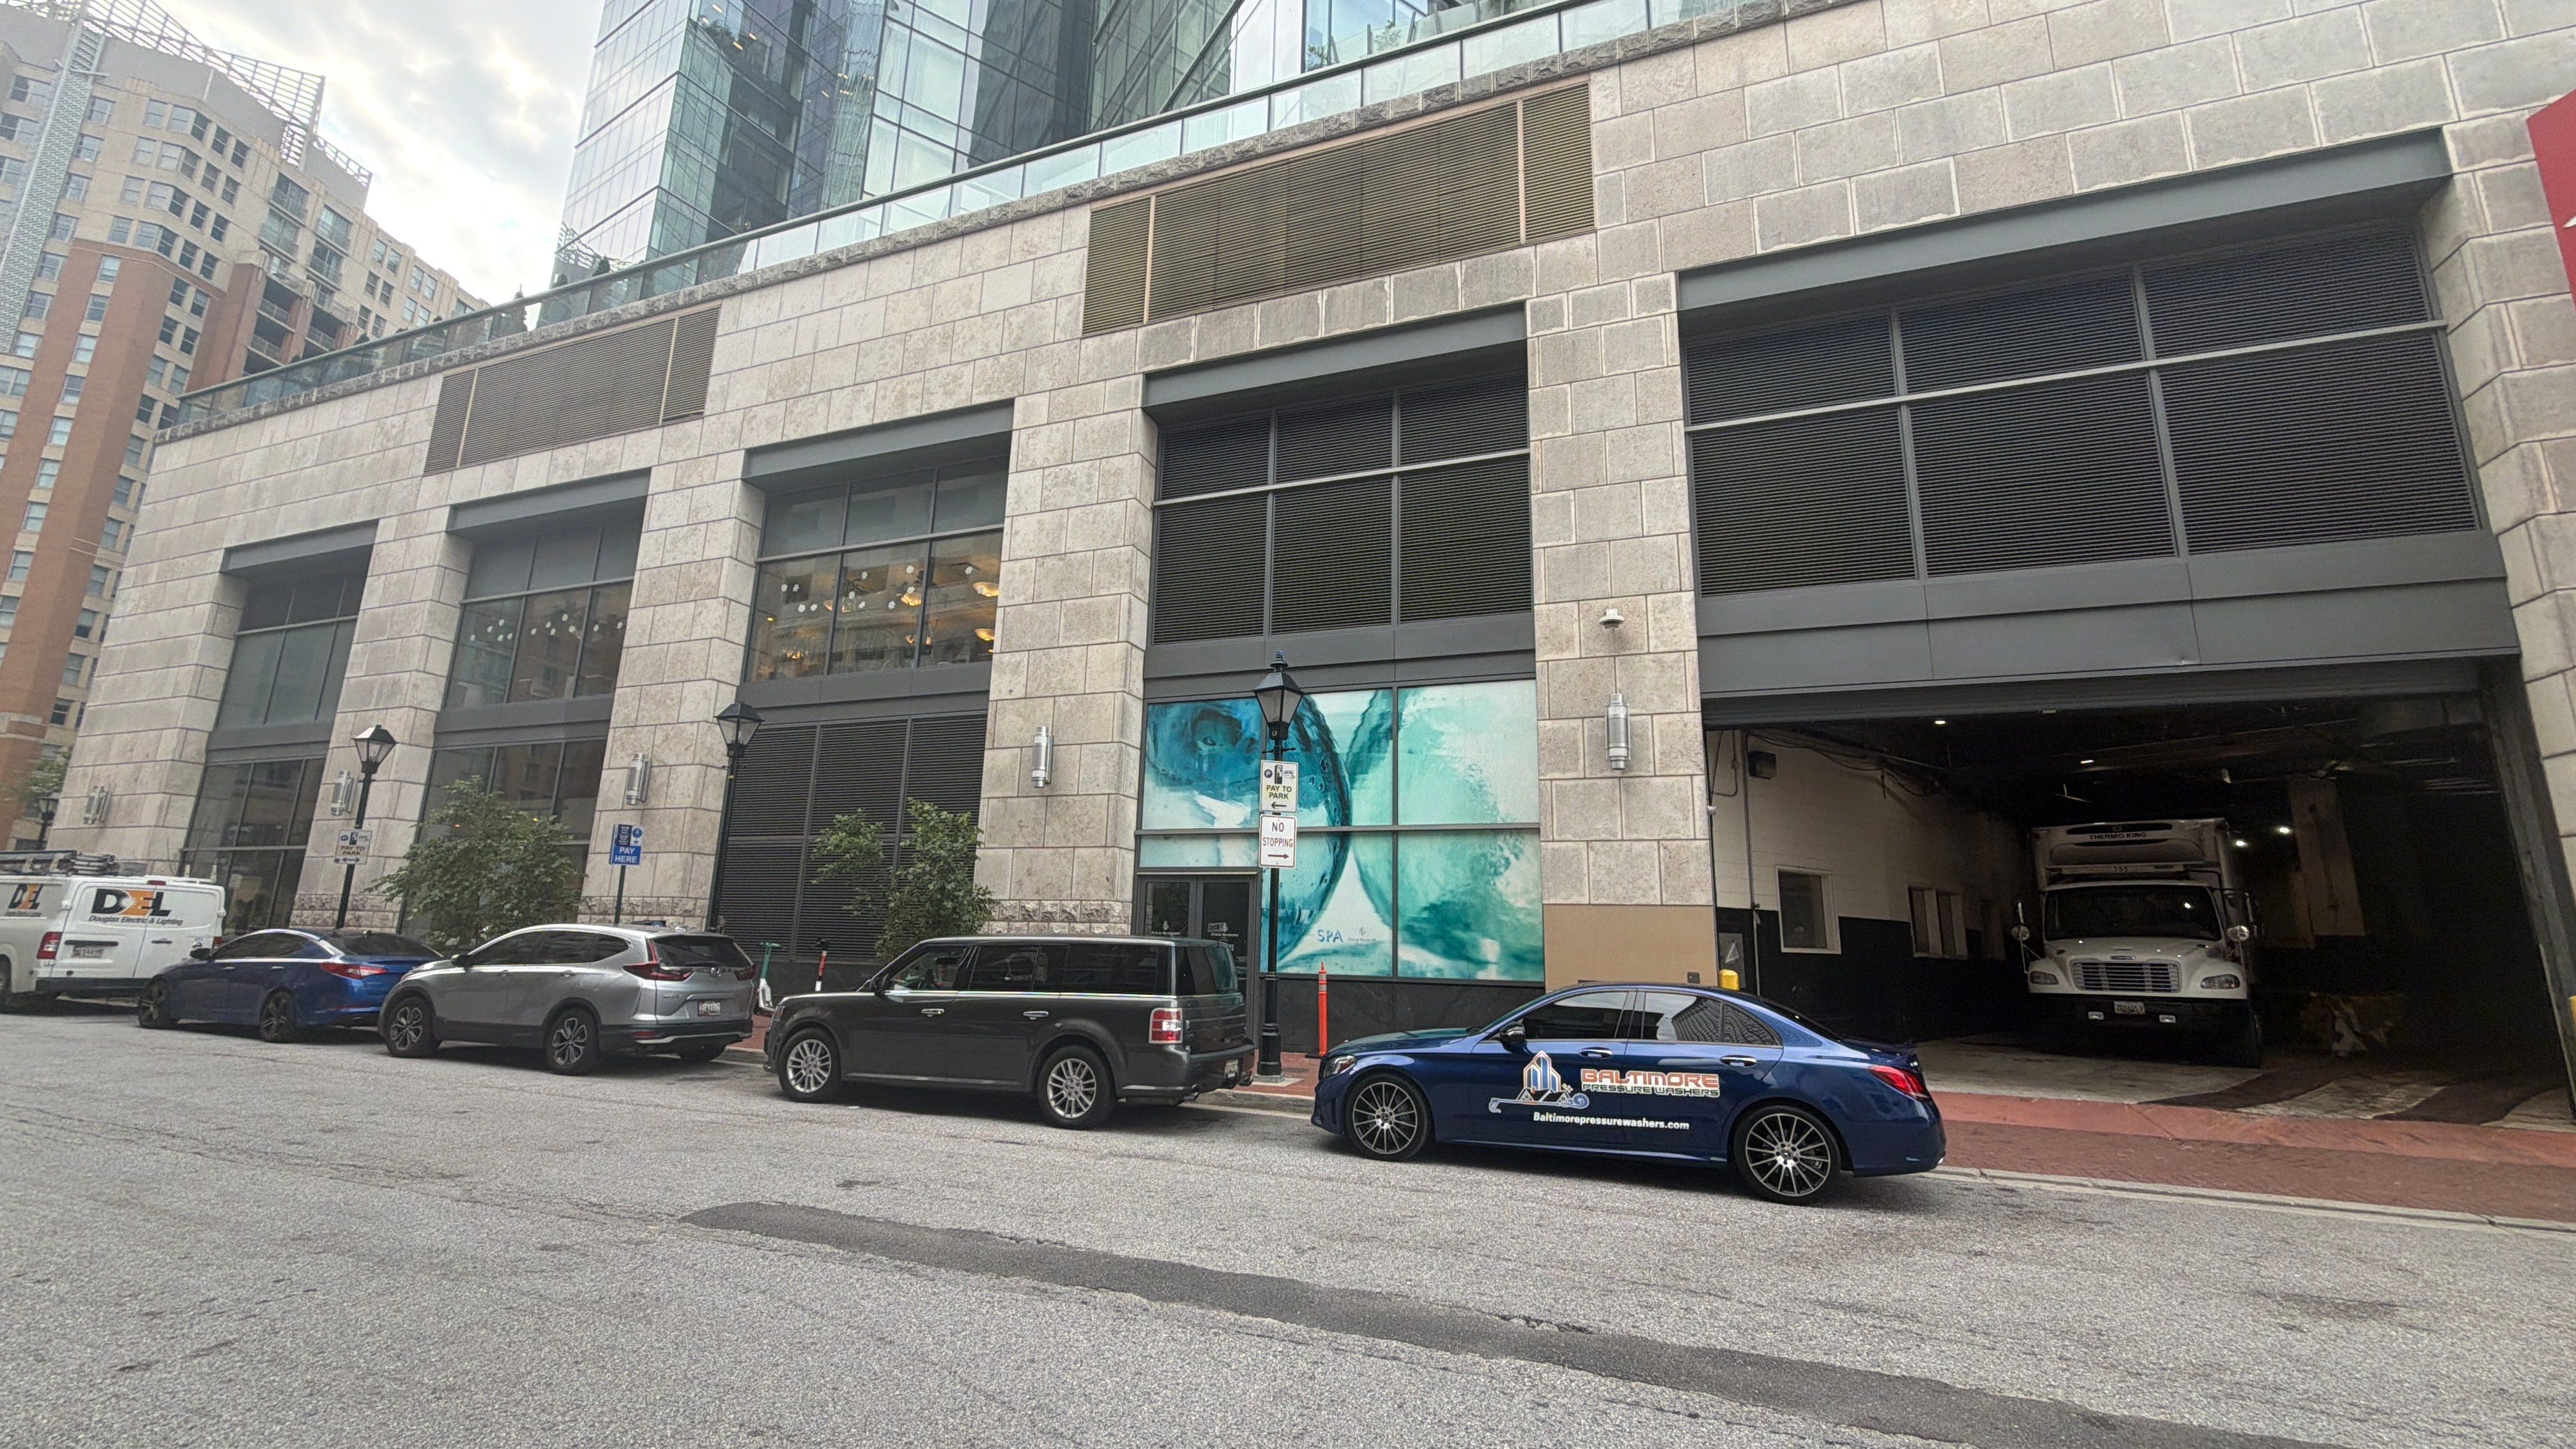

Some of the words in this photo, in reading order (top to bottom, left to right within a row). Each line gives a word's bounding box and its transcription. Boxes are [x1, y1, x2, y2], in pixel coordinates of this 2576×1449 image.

[1272, 822, 1284, 832] NO
[1262, 837, 1293, 848] STOPPING
[88, 915, 119, 923] Douglas
[1317, 929, 1344, 942] SPA
[1581, 1070, 1719, 1088] BALTIMORE
[1583, 1084, 1652, 1093] PRESSURE
[1654, 1087, 1719, 1097] WASHERS
[1533, 1112, 1689, 1130] Baltimorepressurewashers.com
